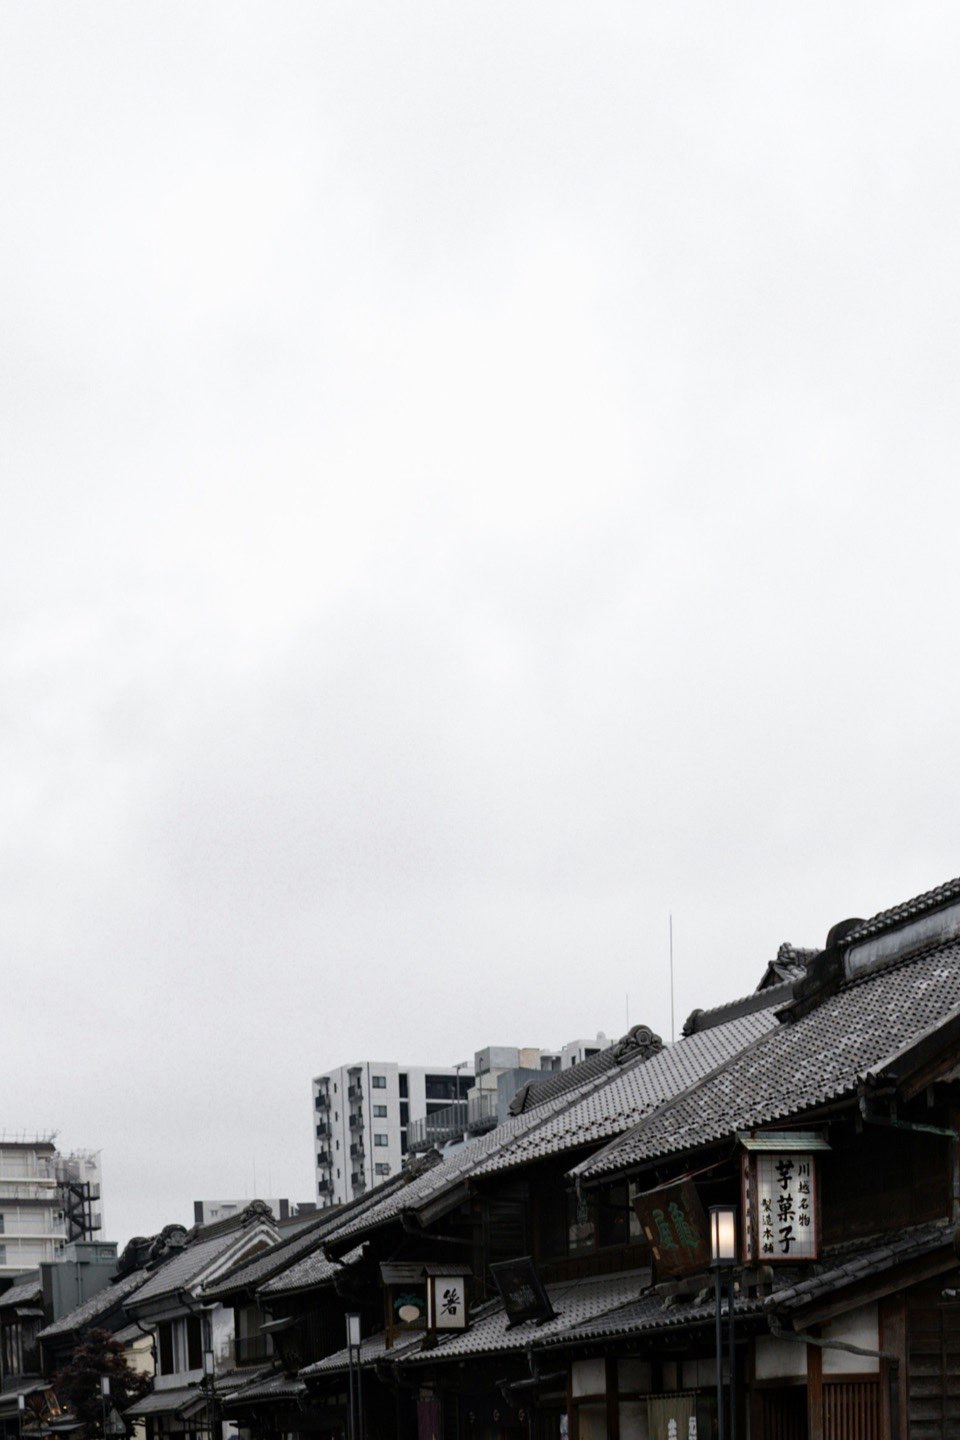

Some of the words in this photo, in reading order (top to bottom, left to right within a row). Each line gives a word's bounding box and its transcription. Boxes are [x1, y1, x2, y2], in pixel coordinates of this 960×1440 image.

[775, 1160, 796, 1253] 芋菓子
[798, 1163, 811, 1227] 川越名物
[440, 1288, 461, 1316] 箸
